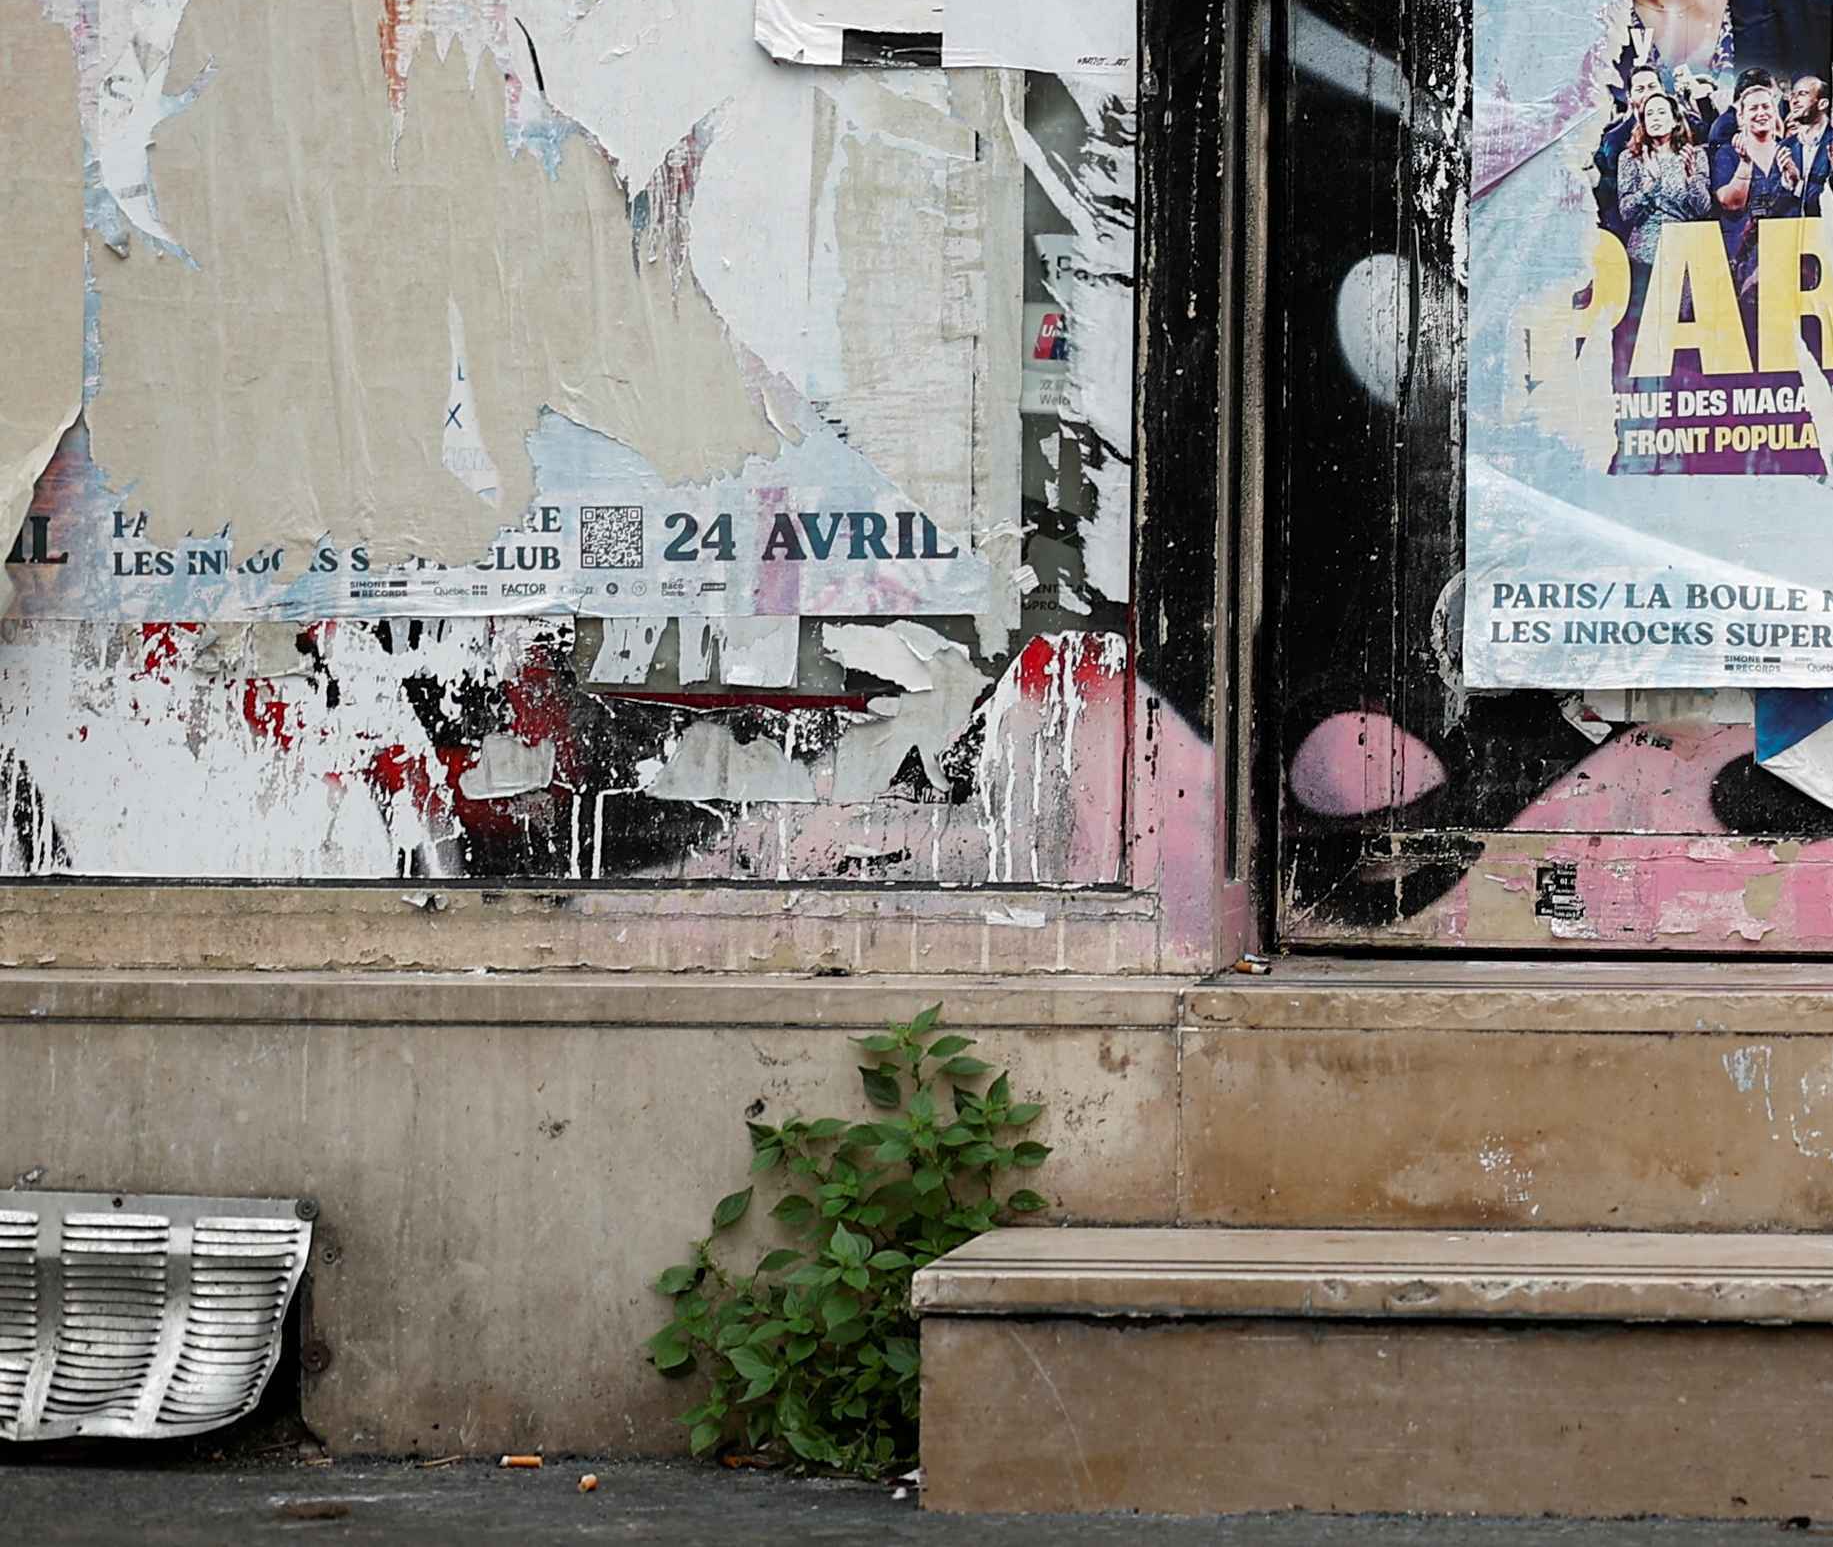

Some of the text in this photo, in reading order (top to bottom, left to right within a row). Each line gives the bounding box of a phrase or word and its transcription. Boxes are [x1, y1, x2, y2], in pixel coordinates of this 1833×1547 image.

[662, 511, 959, 562] 24 AVRIL
[1626, 583, 1673, 612] LA
[1687, 585, 1808, 613] BOULE
[1491, 621, 1554, 647] LES
[1563, 621, 1715, 648] INROCKS
[1726, 622, 1833, 649] SUPER
